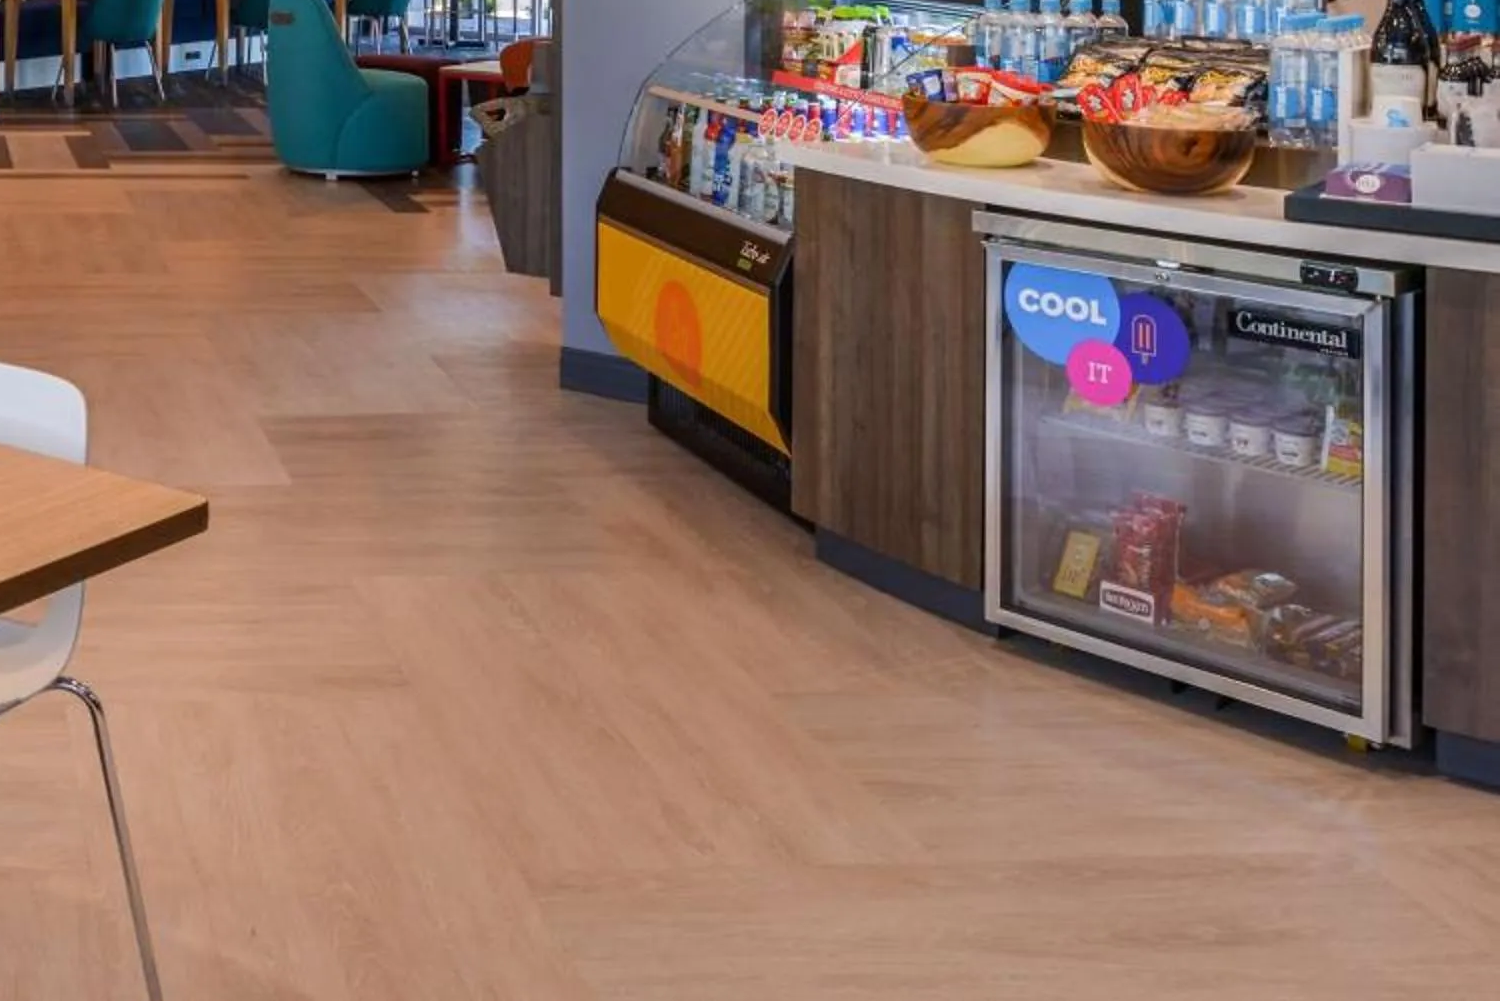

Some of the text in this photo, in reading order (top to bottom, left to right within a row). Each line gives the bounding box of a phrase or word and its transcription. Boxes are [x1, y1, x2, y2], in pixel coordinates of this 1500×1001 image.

[1018, 287, 1107, 326] COOL
[1236, 310, 1348, 348] Continental
[1087, 360, 1113, 384] IT
